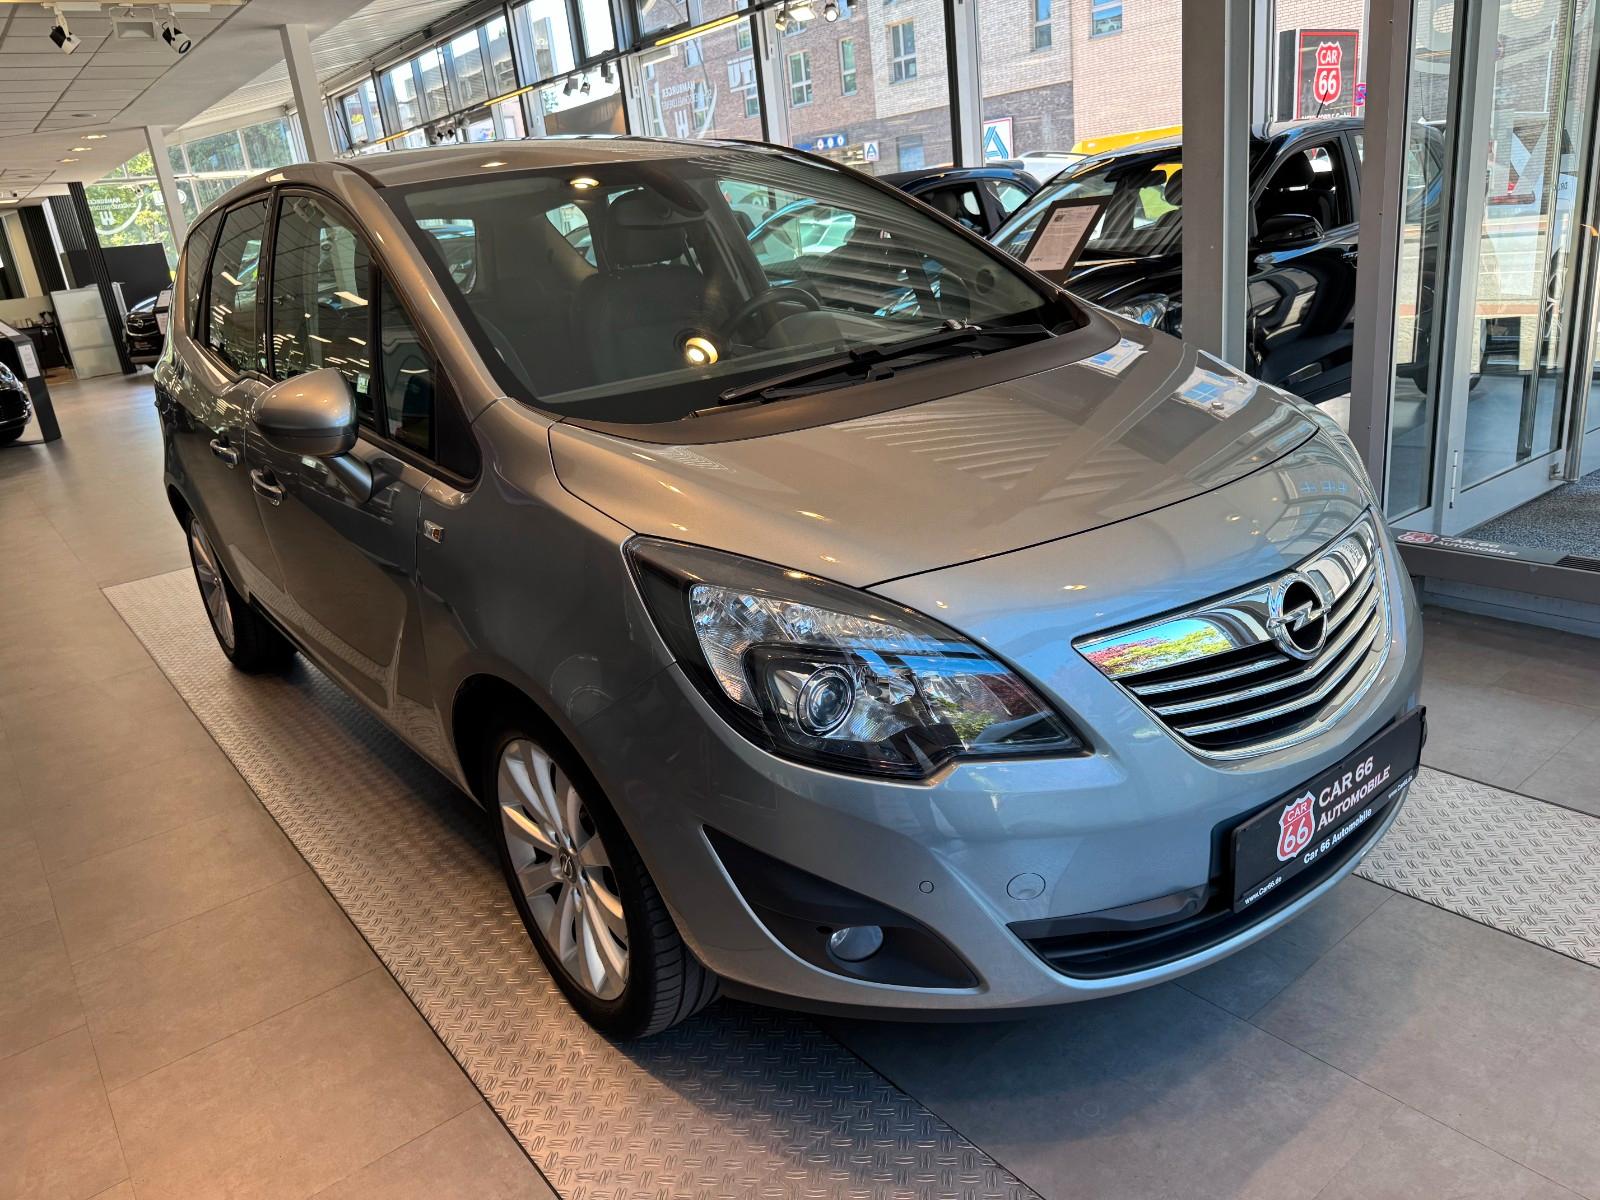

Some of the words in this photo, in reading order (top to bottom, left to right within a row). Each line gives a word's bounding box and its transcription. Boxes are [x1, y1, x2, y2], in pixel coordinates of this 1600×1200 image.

[1320, 50, 1337, 64] CAR
[1318, 70, 1337, 95] 66
[1434, 540, 1519, 556] AUTOMOBILE
[1318, 772, 1353, 808] CAR
[1355, 755, 1374, 782] 66
[1287, 802, 1308, 822] CAR
[1316, 764, 1391, 832] AUTOMOBILE
[1283, 817, 1309, 853] 66
[1304, 849, 1319, 864] Car
[1320, 839, 1331, 853] 66
[1331, 808, 1372, 845] Automobile
[1244, 876, 1282, 905] www.Car66.de
